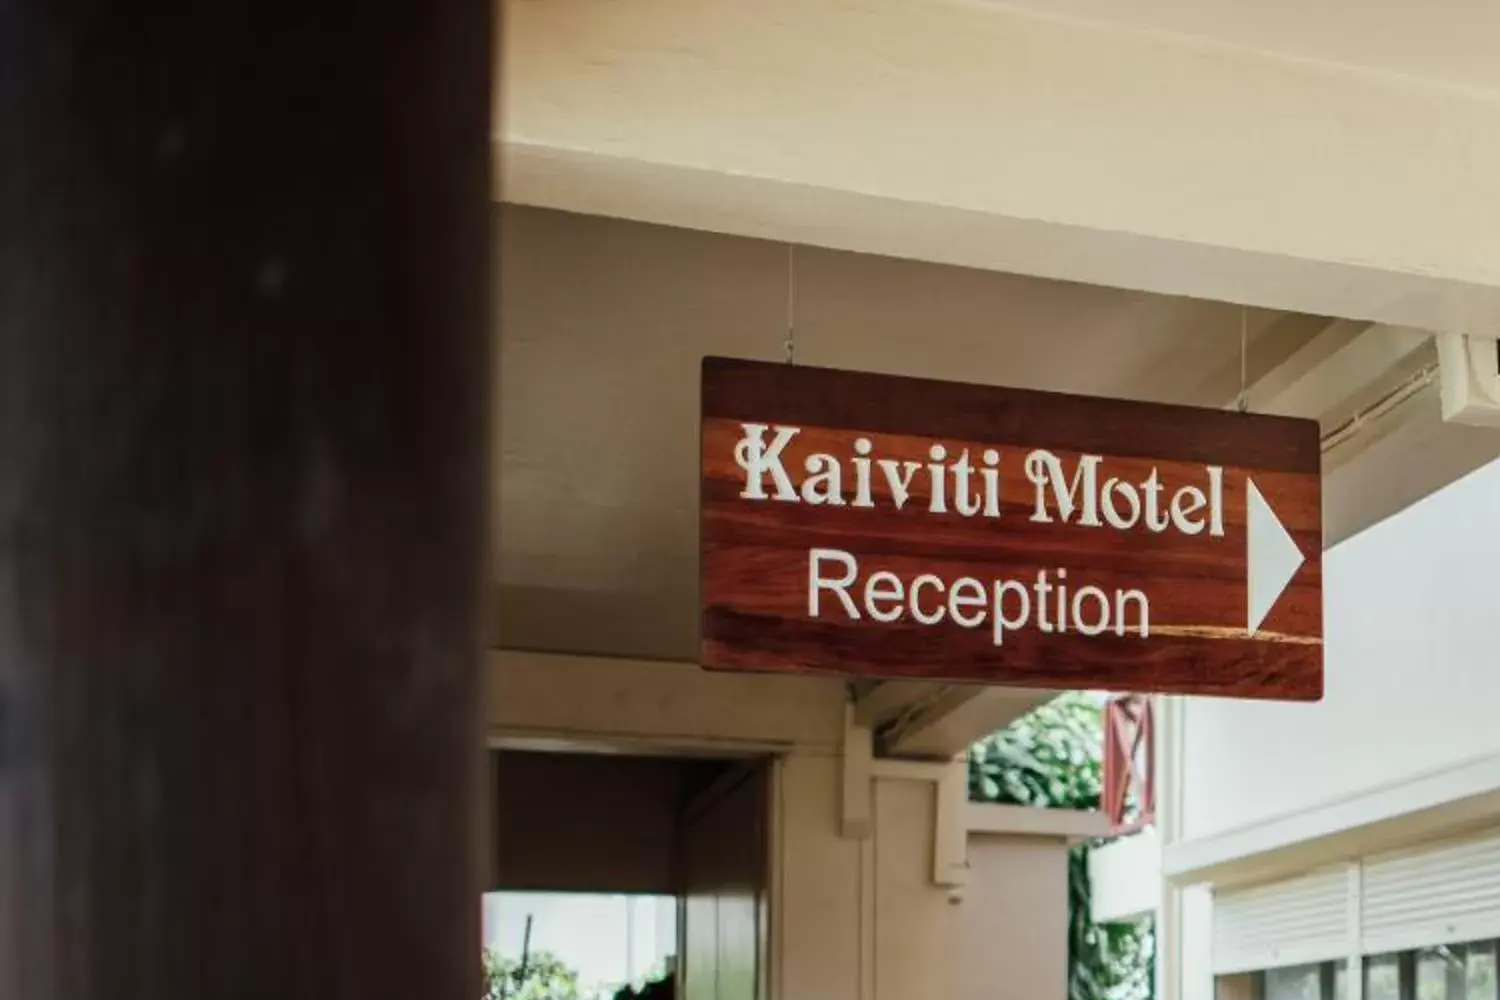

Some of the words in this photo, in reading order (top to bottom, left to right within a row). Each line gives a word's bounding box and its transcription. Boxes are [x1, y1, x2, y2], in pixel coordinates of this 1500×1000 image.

[734, 423, 999, 517] Kaiviti
[1024, 448, 1225, 537] Motel
[807, 547, 1150, 646] Reception
